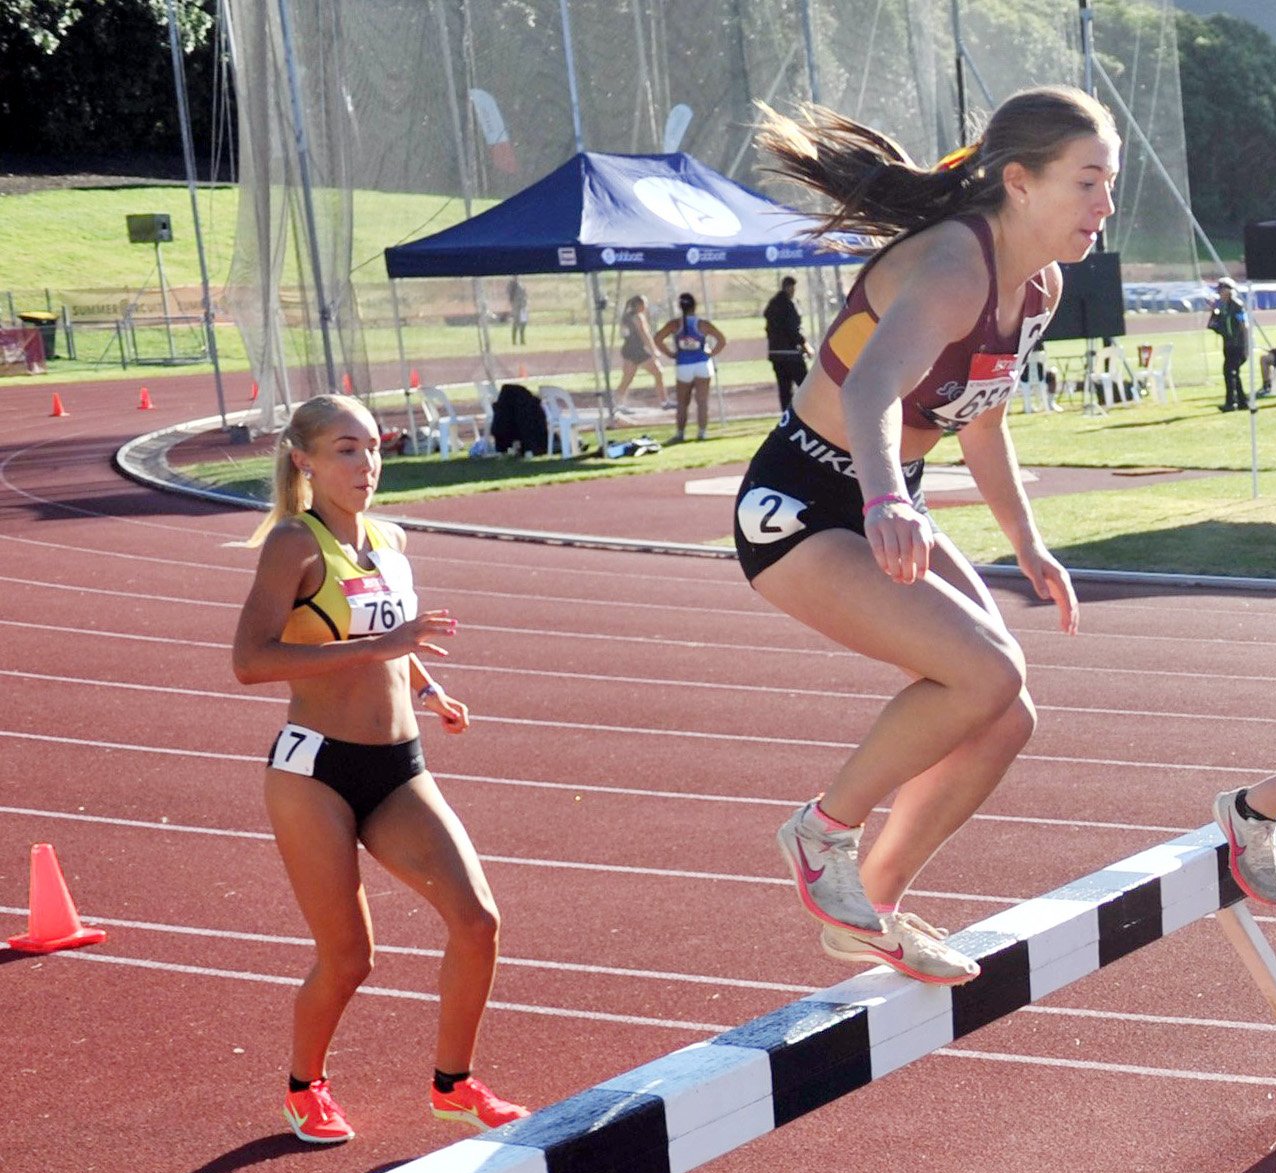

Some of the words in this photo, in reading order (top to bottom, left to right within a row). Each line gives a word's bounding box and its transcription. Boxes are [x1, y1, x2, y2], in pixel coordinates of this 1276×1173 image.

[759, 494, 783, 533] 2
[364, 599, 407, 631] 761
[287, 731, 307, 763] 7
